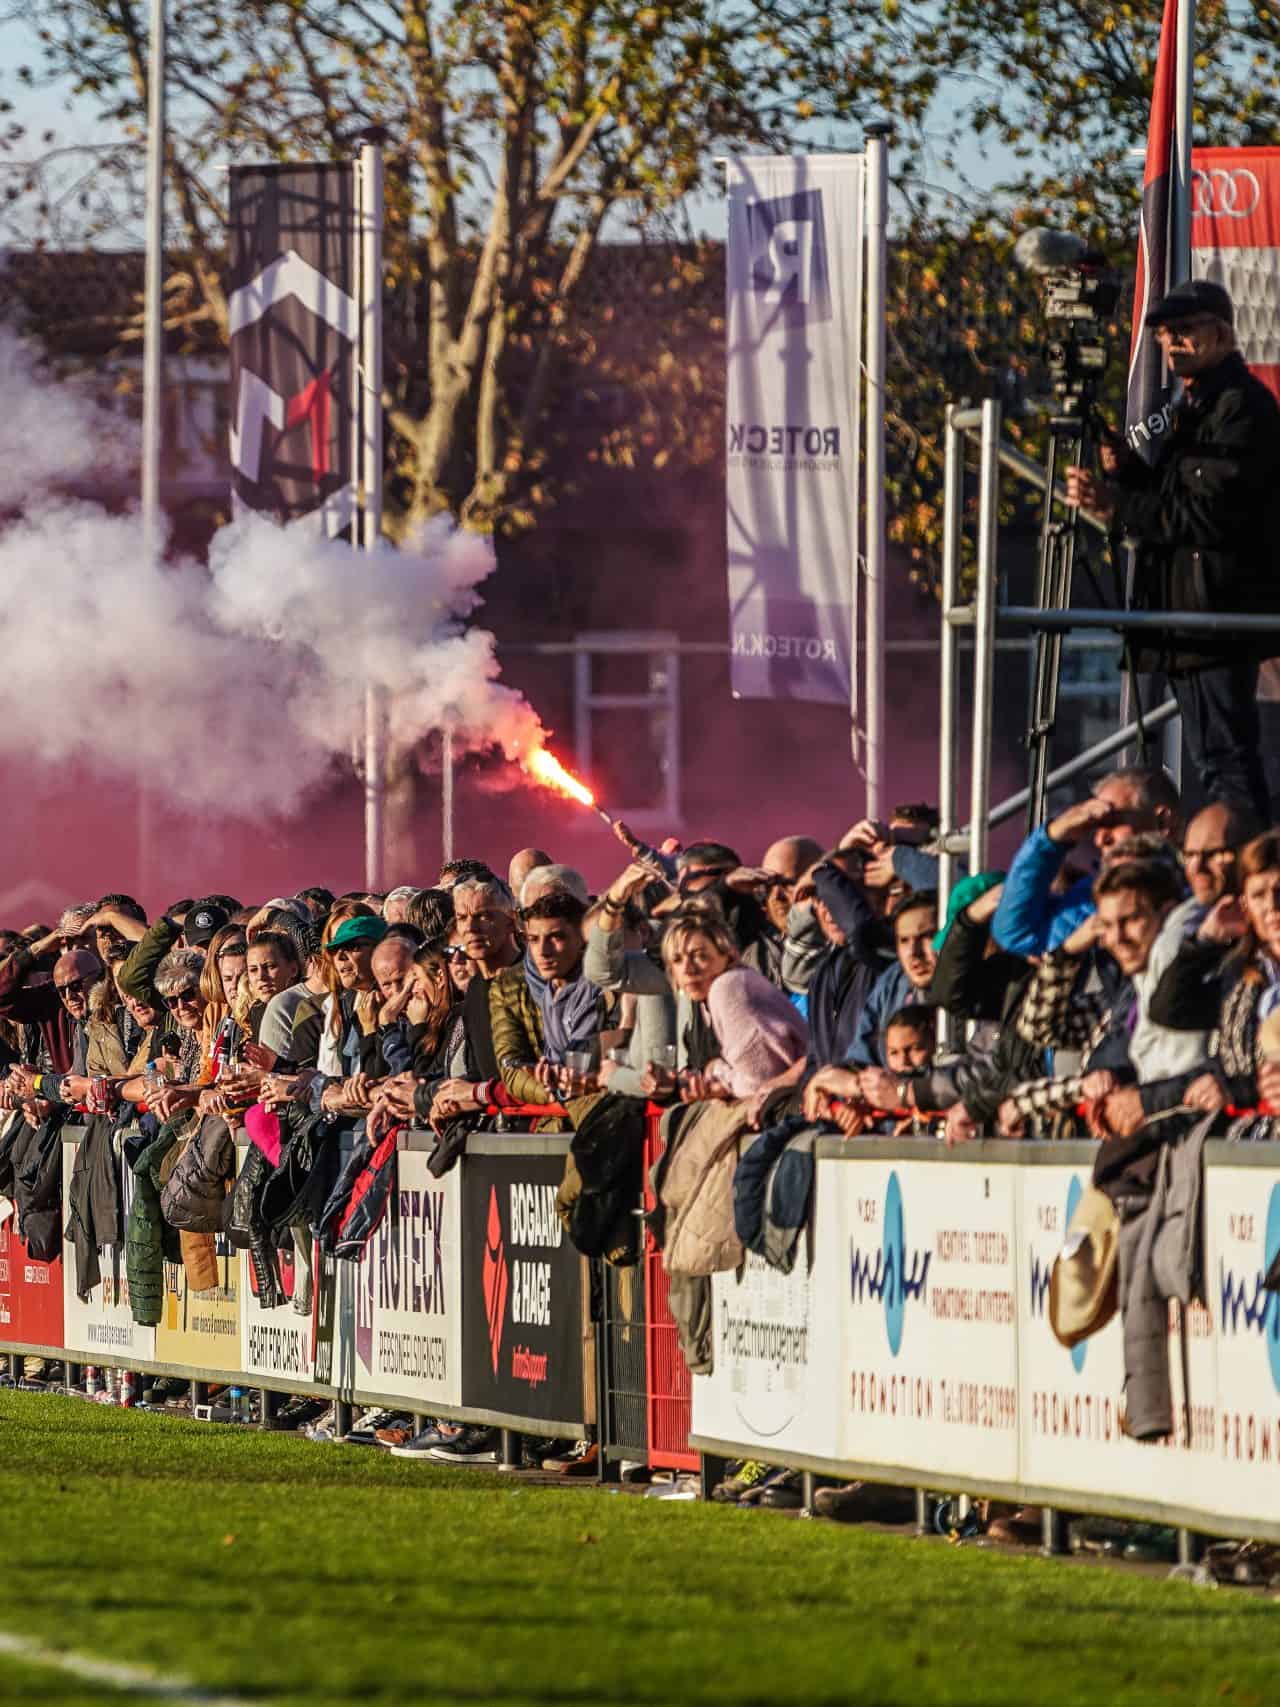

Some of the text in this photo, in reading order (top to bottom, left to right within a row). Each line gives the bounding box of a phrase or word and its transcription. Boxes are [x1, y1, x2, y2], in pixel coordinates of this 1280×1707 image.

[510, 1182, 563, 1248] BOGAARD
[512, 1258, 552, 1327] & HAGE
[248, 1325, 269, 1369] HEART
[269, 1327, 282, 1370] FOR
[850, 1371, 934, 1417] PROMOTION
